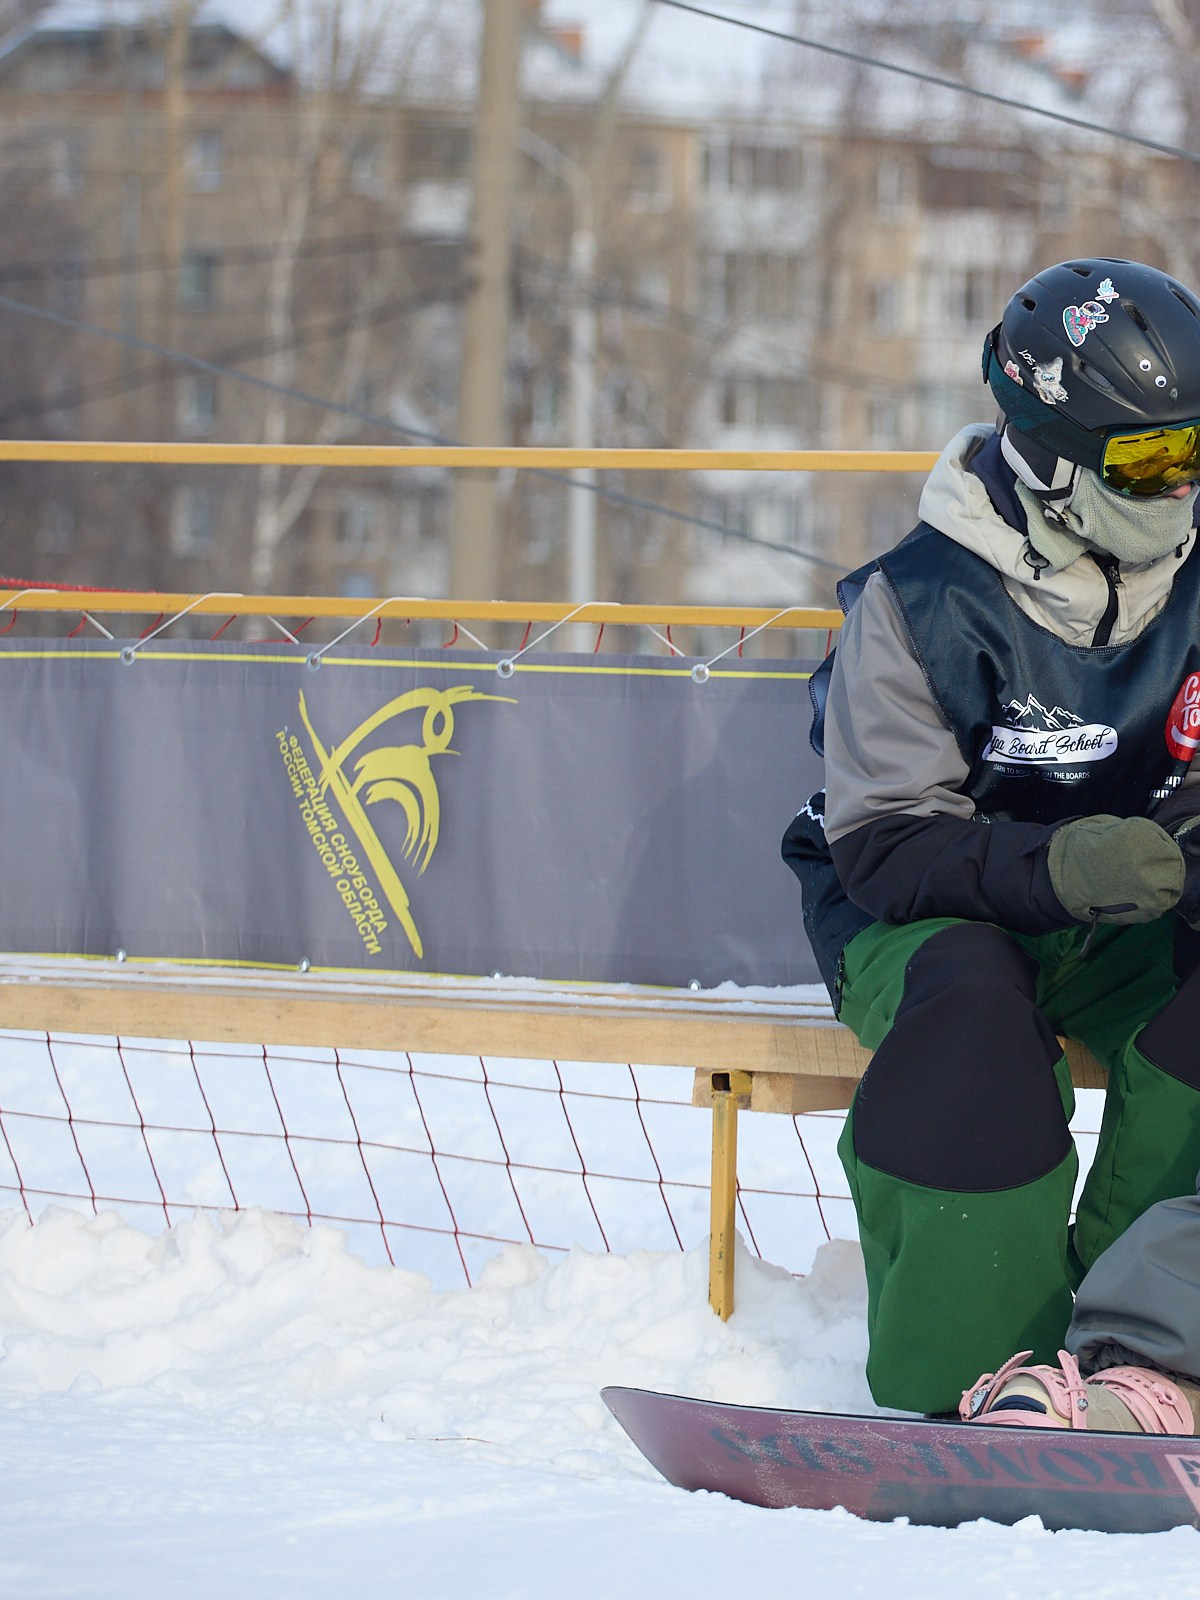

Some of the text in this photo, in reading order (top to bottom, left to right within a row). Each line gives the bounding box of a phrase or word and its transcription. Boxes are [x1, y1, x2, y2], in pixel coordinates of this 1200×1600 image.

[1009, 735, 1057, 755] Board
[1056, 728, 1111, 755] School
[1053, 772, 1065, 780] THE
[1065, 771, 1091, 780] BOARDS
[276, 731, 382, 955] РОССИИ ТОМСКОЙ ОБЛАСТИ
[289, 735, 388, 933] ФЕДЕРАЦИЯ СНОУБОРДА
